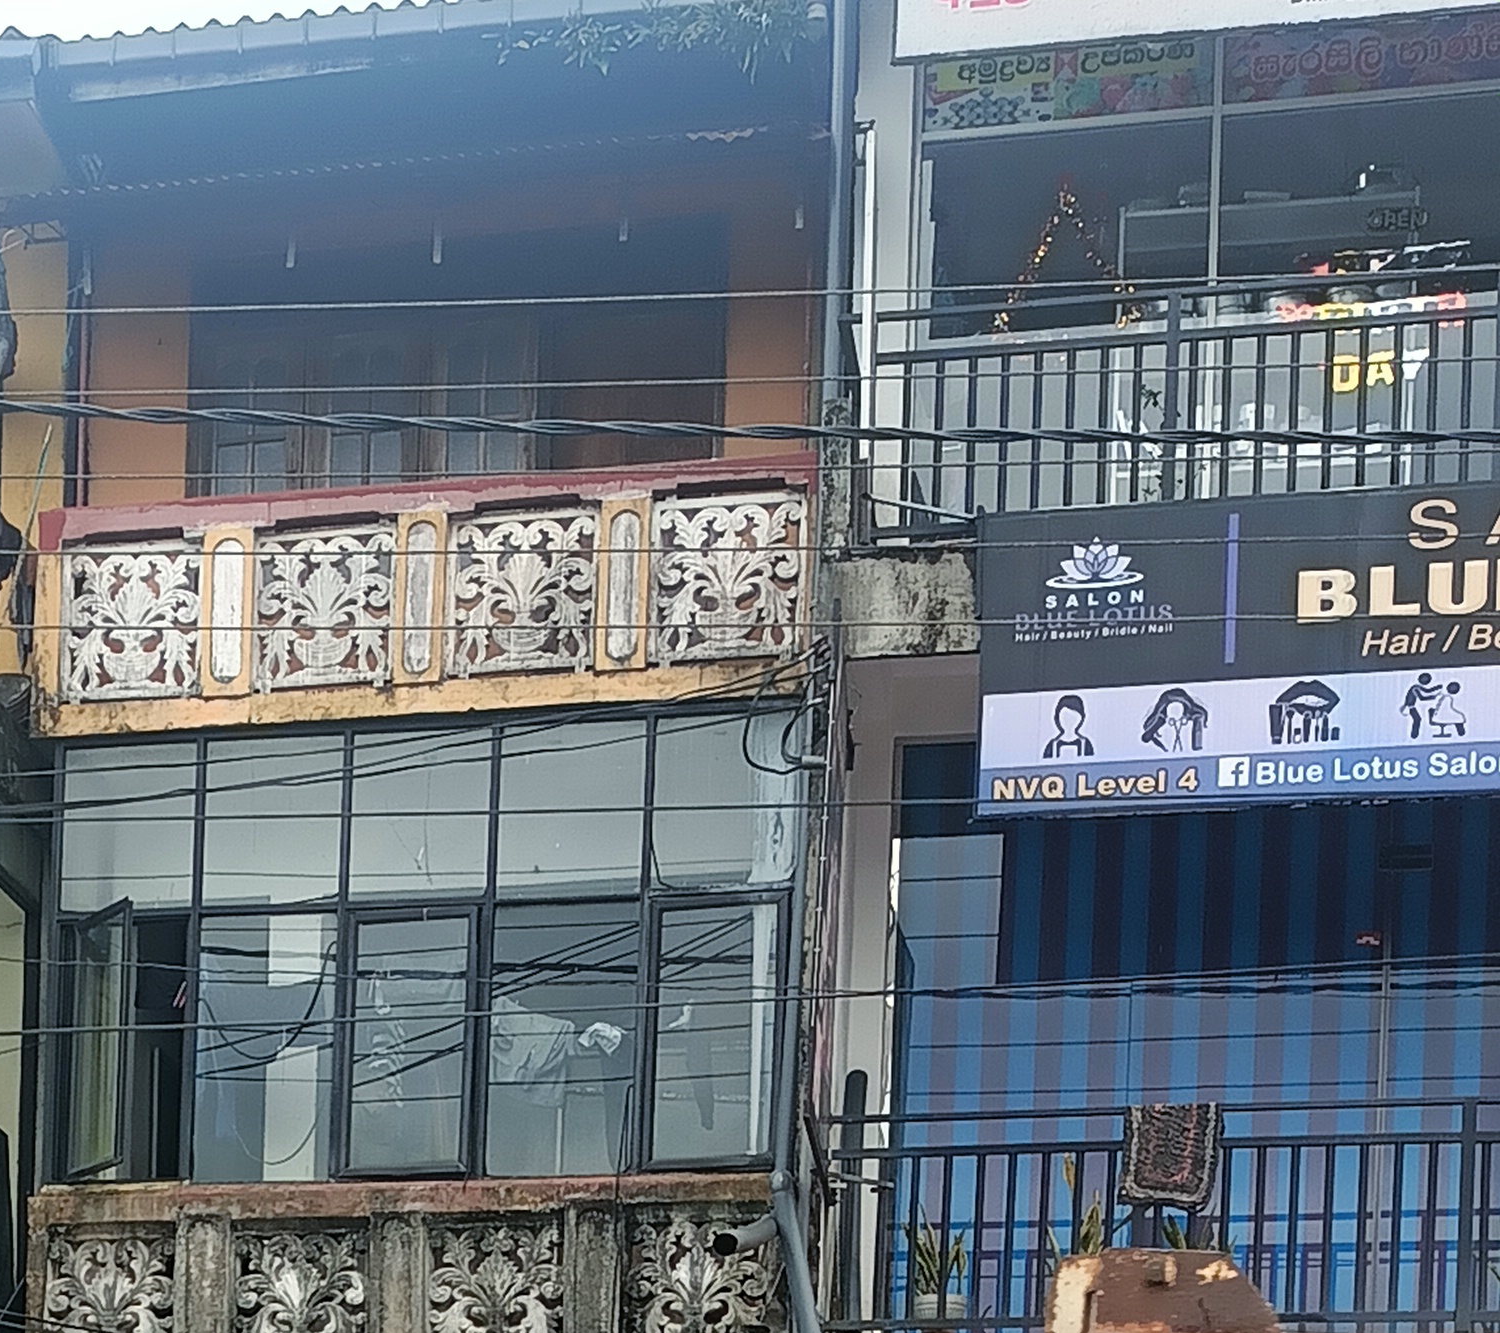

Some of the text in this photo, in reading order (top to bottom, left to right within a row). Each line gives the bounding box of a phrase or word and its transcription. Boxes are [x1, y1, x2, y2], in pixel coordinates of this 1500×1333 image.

[1045, 589, 1145, 610] SALON
[1297, 559, 1500, 622] BLU
[1361, 627, 1437, 657] Hair
[991, 767, 1199, 801] NVQ Level 4
[1255, 760, 1323, 787] Blue
[1333, 756, 1420, 783] Lotus
[1429, 750, 1500, 778] Salo
